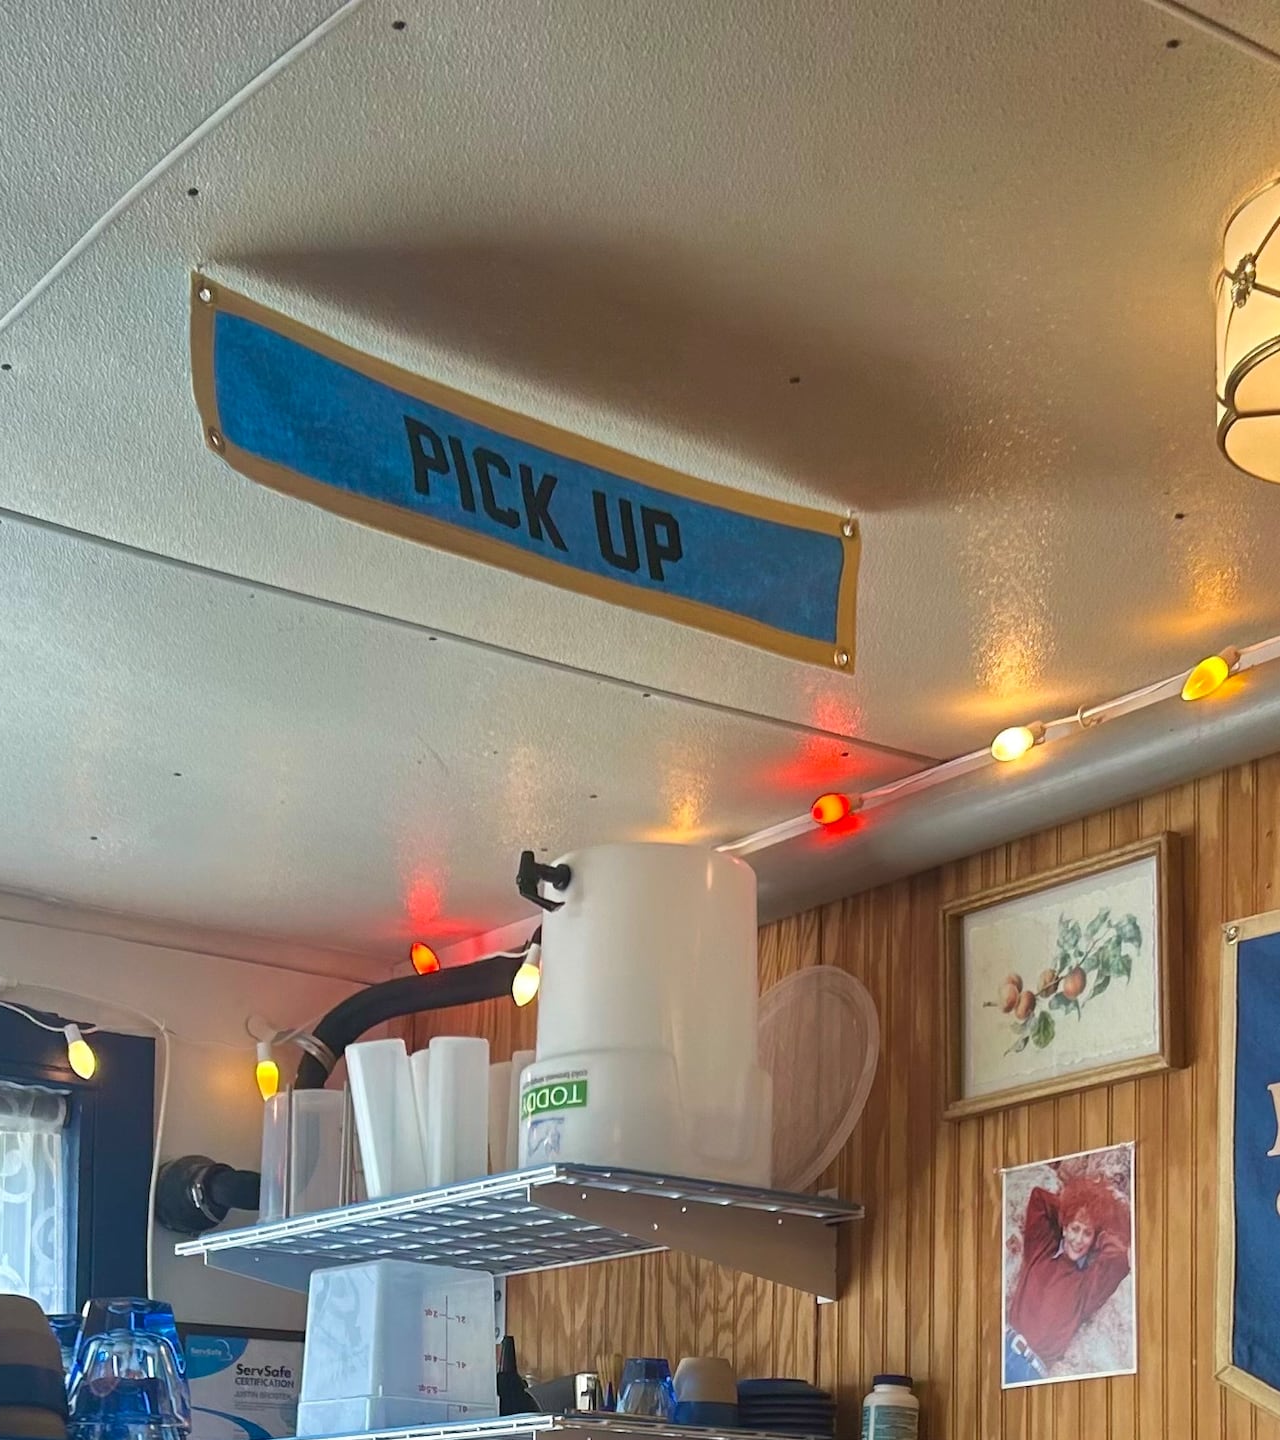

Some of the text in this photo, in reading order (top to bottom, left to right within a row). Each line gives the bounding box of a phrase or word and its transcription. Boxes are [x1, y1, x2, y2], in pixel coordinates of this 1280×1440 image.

[403, 414, 683, 581] PICK UP
[522, 1084, 583, 1115] TODDY
[236, 1363, 292, 1378] ServSafe
[234, 1377, 294, 1389] CERTIFICATION
